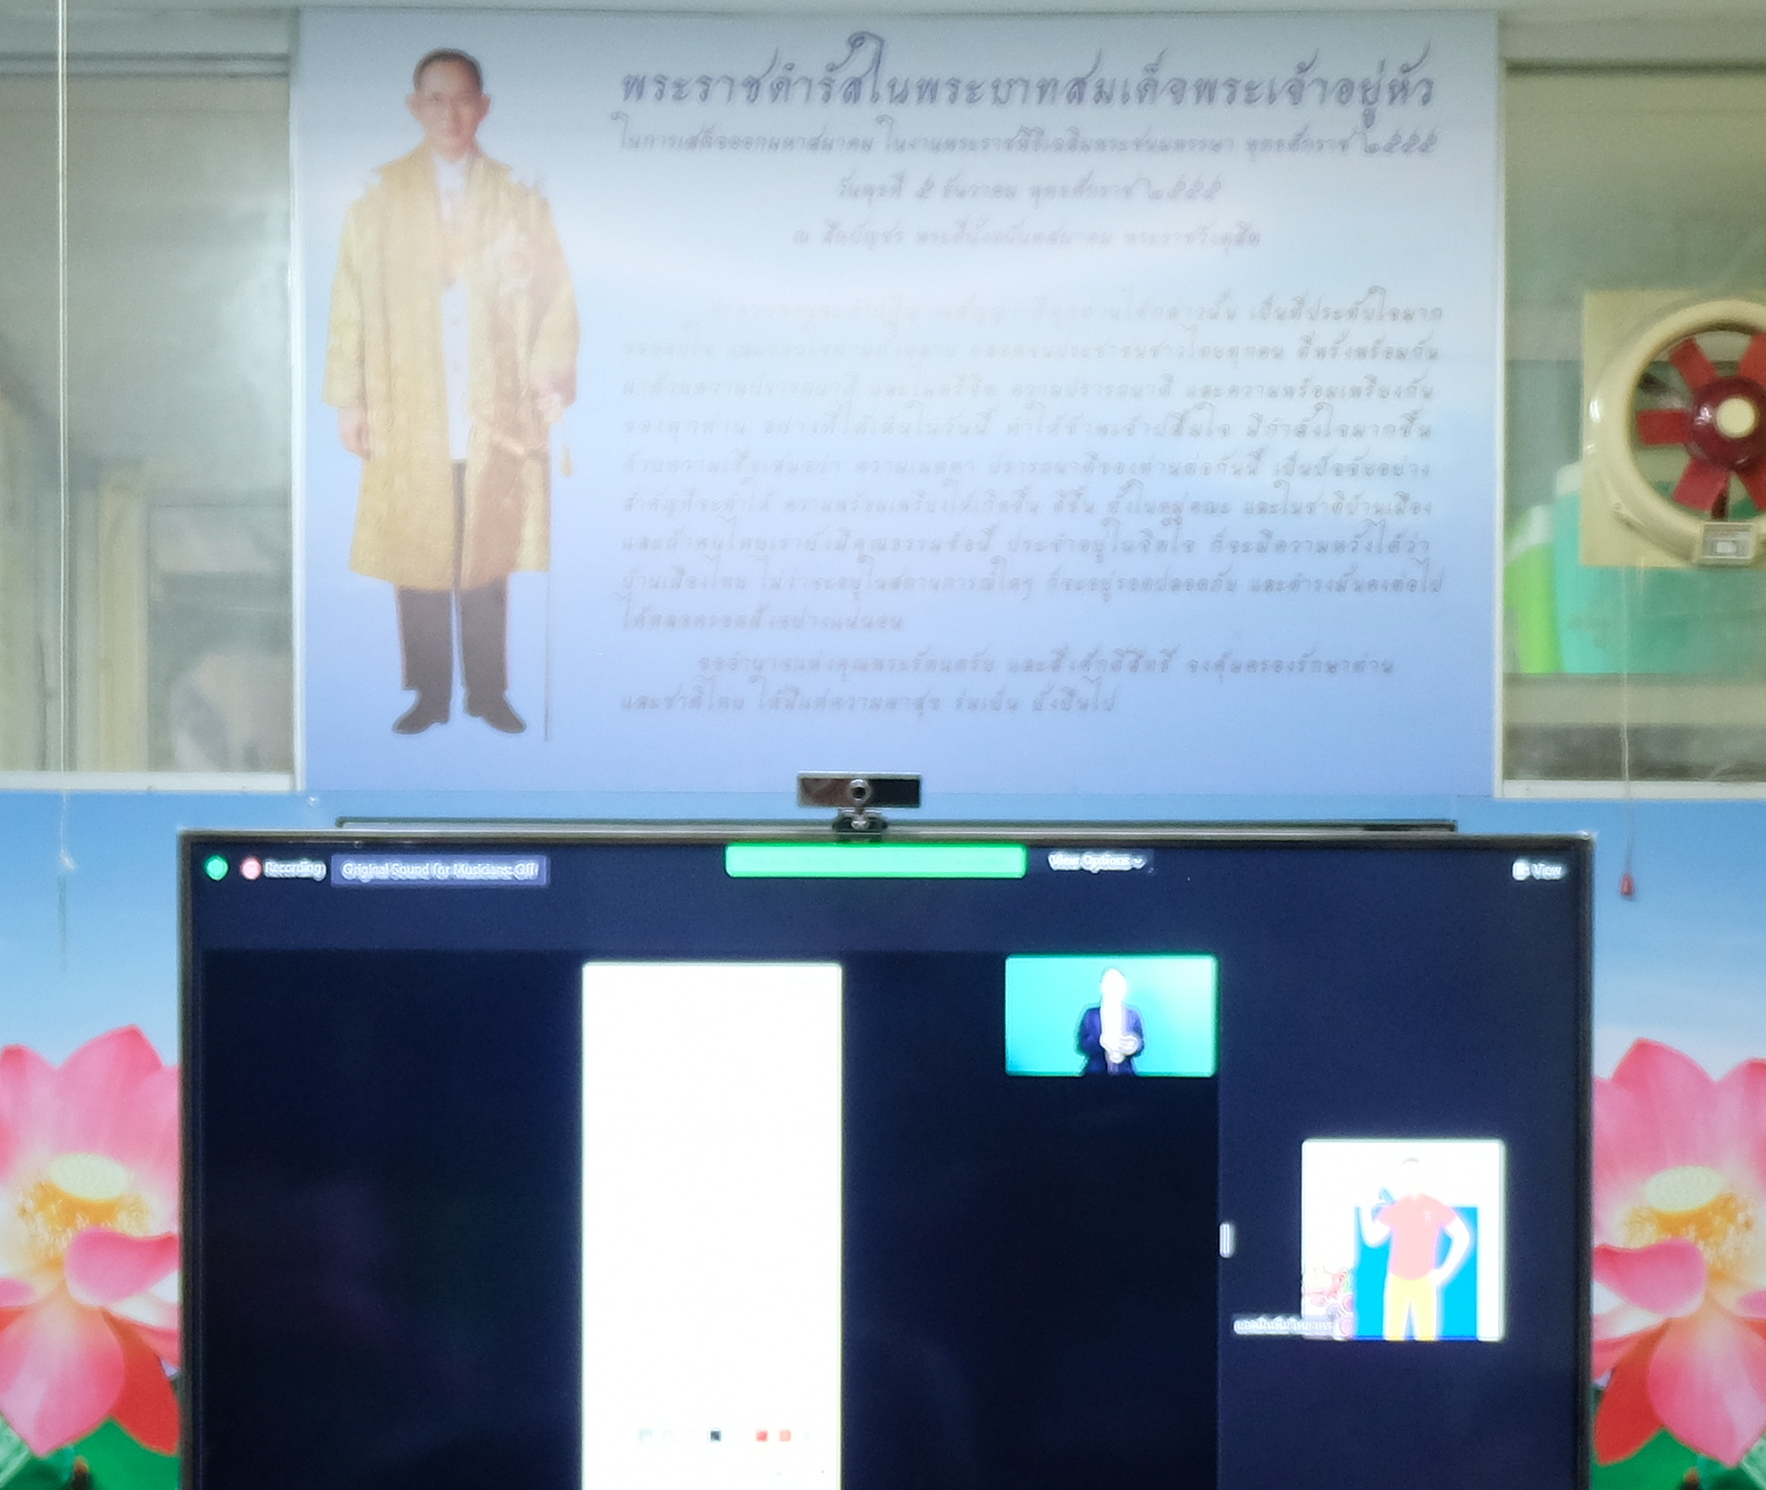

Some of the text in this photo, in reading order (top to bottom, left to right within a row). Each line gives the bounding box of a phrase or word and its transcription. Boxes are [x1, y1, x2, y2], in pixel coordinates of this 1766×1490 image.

[264, 860, 325, 880] Recording
[341, 860, 390, 882] Original
[391, 860, 431, 878] Sound
[1531, 861, 1564, 879] View
